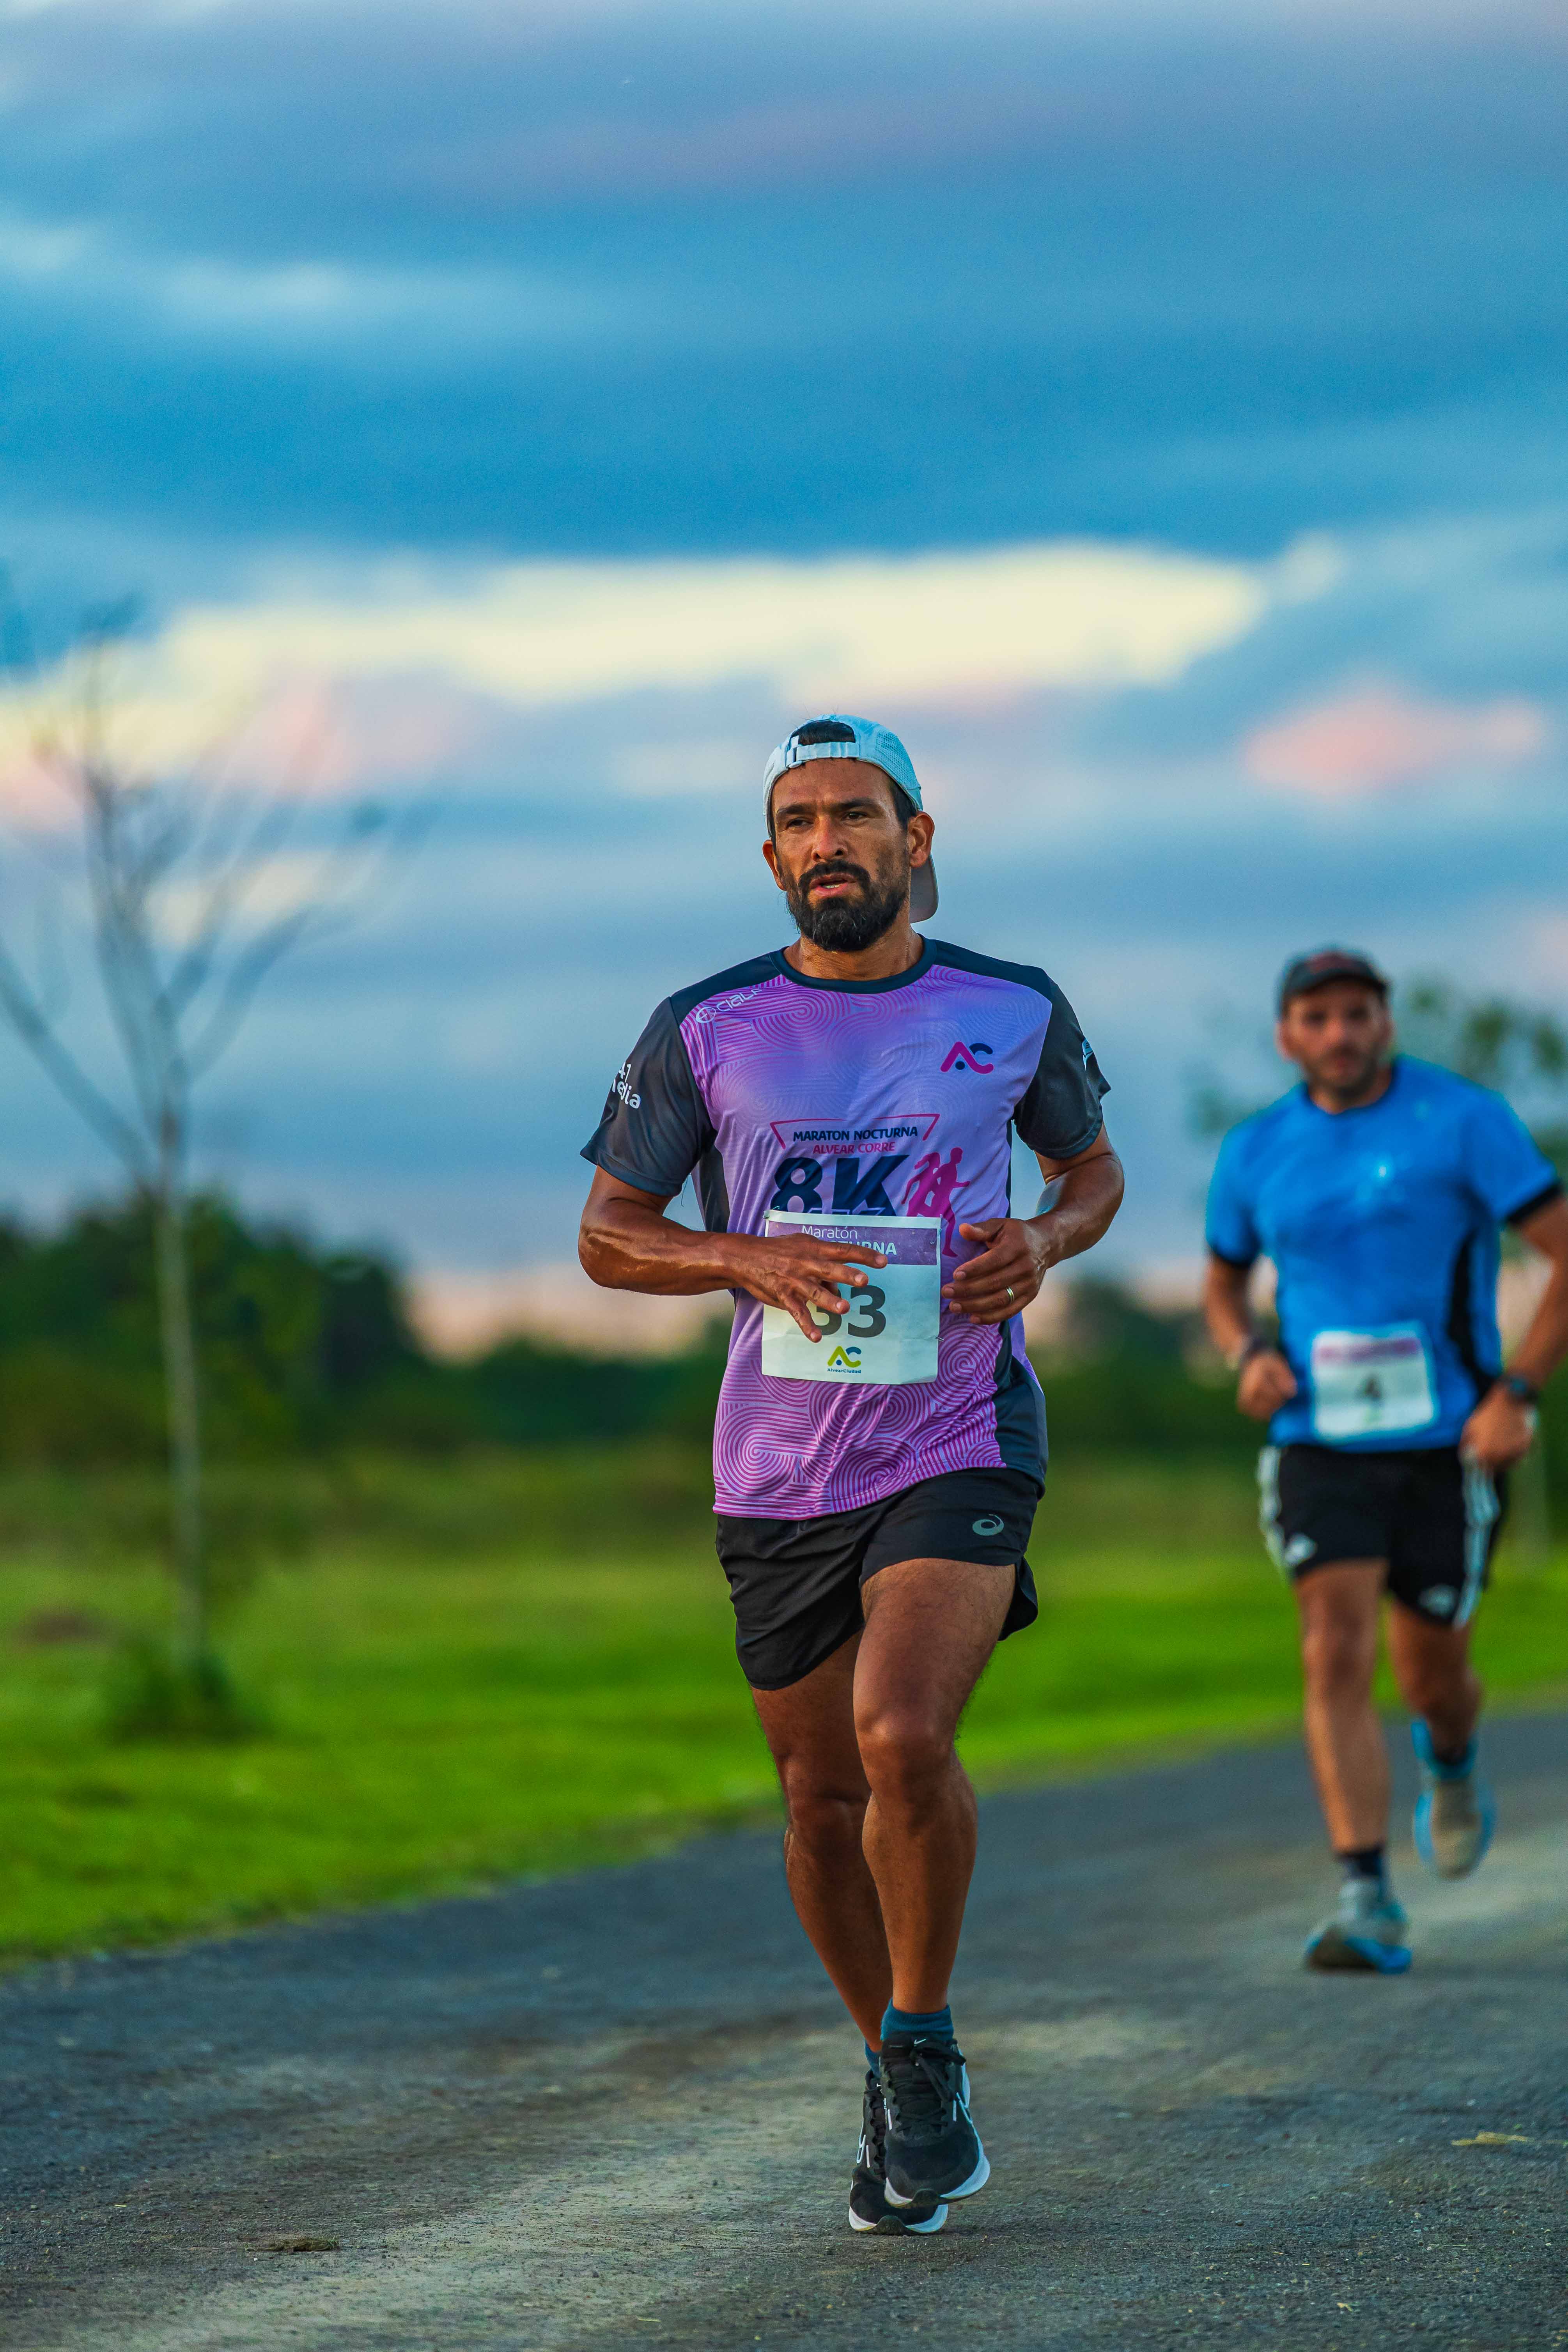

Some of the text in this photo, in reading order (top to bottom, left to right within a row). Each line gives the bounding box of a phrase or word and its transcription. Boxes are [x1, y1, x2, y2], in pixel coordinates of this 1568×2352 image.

[793, 1126, 918, 1142] MARATON NOCTURNA
[813, 1141, 895, 1155] ALVEAR CORRE
[770, 1155, 909, 1216] 8K
[802, 1225, 858, 1239] Maratón
